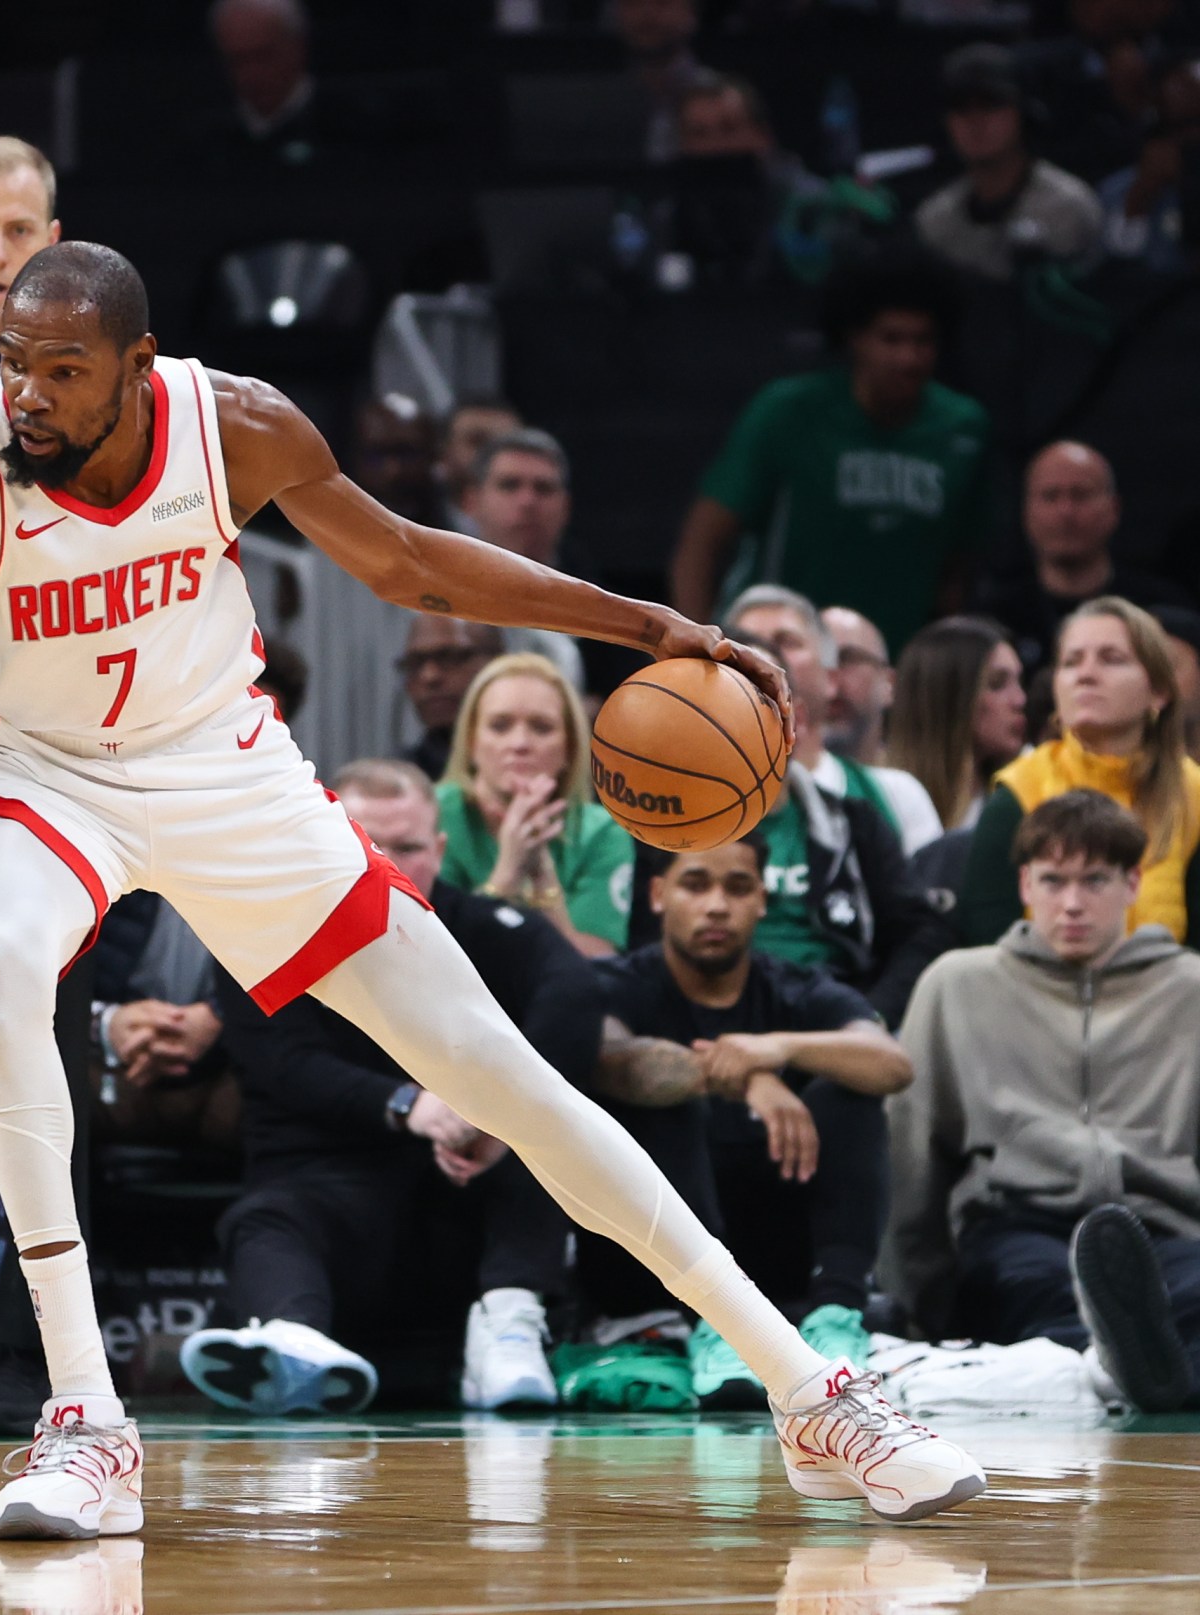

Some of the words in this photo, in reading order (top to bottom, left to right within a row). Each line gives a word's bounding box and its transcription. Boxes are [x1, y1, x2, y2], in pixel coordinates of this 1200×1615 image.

[152, 490, 205, 514] MEMORIAL
[152, 495, 205, 522] HERMANN
[7, 547, 206, 642] ROCKETS
[96, 648, 138, 728] 7
[592, 755, 685, 816] Wilson
